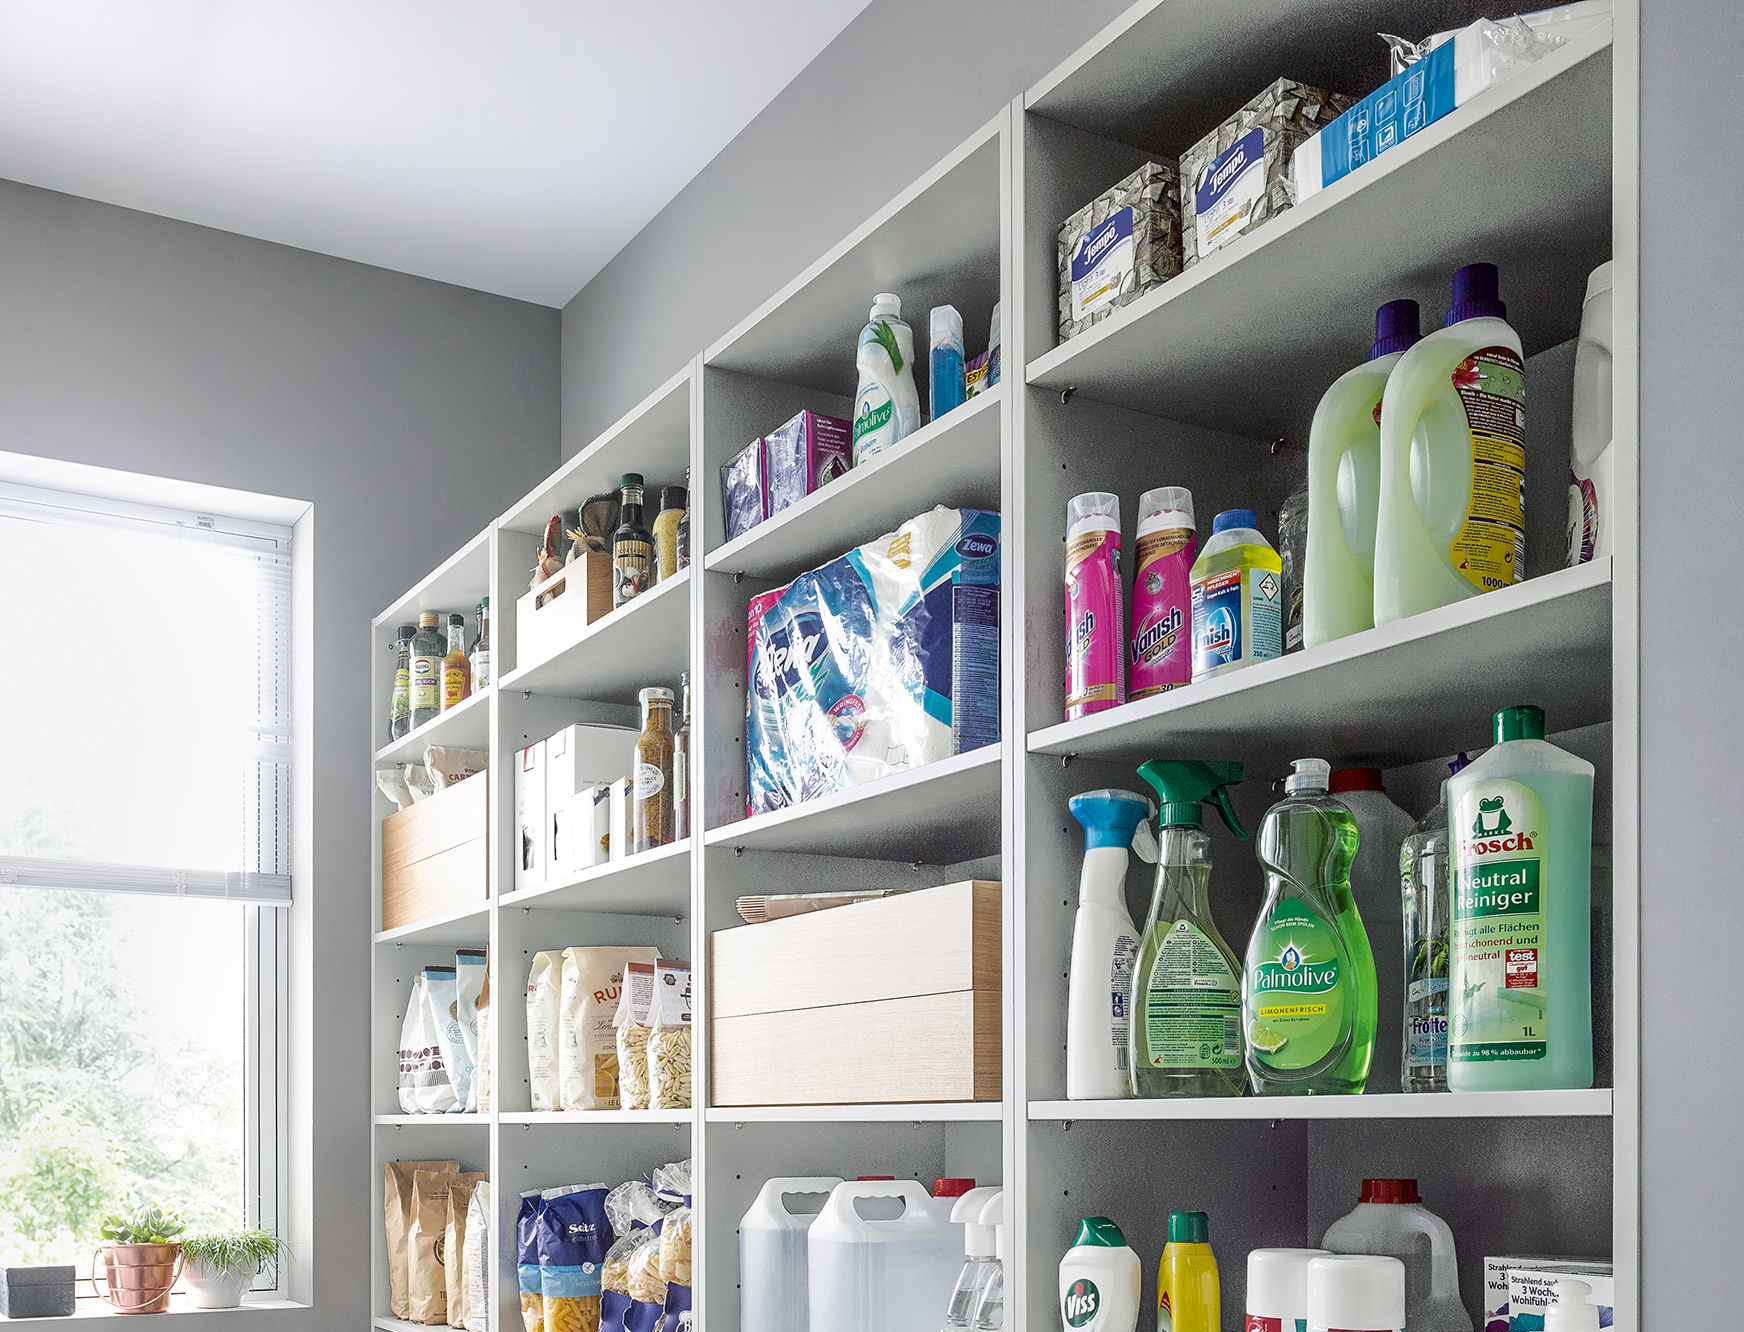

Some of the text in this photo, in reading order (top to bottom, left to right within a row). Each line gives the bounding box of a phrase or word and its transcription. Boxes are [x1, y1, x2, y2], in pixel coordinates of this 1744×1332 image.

[1209, 147, 1247, 196] Tempo
[1084, 222, 1118, 265] Tempo
[962, 539, 993, 554] Zewa
[1131, 606, 1184, 666] Vanish
[1144, 634, 1177, 663] GOLD
[1253, 650, 1263, 658] 250
[833, 699, 864, 714] WRINGFEST
[1459, 868, 1526, 891] Neutral
[1457, 891, 1533, 910] Reiniger
[1480, 924, 1496, 935] alle
[1499, 922, 1540, 933] Flächen
[1516, 935, 1538, 944] und
[1508, 950, 1534, 961] test
[1254, 967, 1335, 990] Palmolive
[593, 987, 622, 1004] RU
[1261, 1006, 1324, 1015] LIMONENFRISCH
[1522, 1026, 1536, 1037] 1L
[1500, 1272, 1505, 1281] 3
[1511, 1275, 1542, 1285] Strahlend
[1522, 1285, 1559, 1298] 3 Woch
[1511, 1294, 1558, 1307] Wohlfühl-
